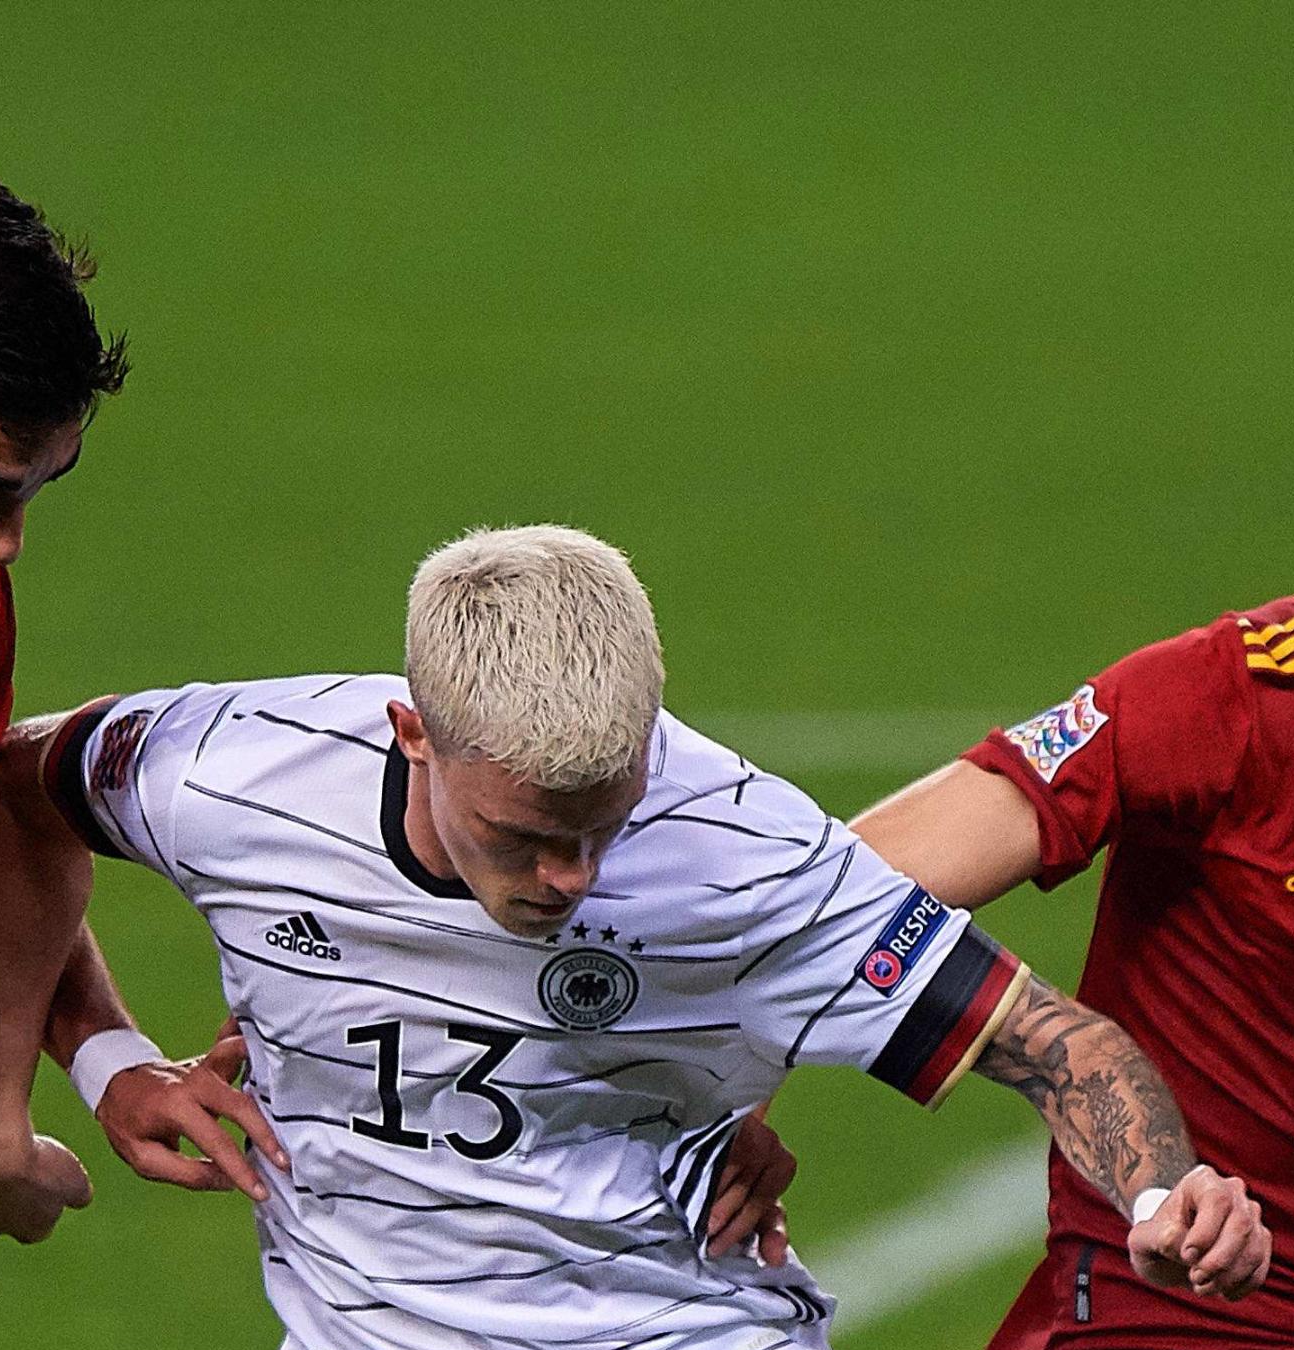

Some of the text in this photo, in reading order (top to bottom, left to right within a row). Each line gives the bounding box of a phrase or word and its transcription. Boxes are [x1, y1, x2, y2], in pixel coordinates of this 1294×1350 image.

[266, 931, 342, 961] adidas
[889, 894, 941, 957] RESPE
[346, 1020, 527, 1162] 13
